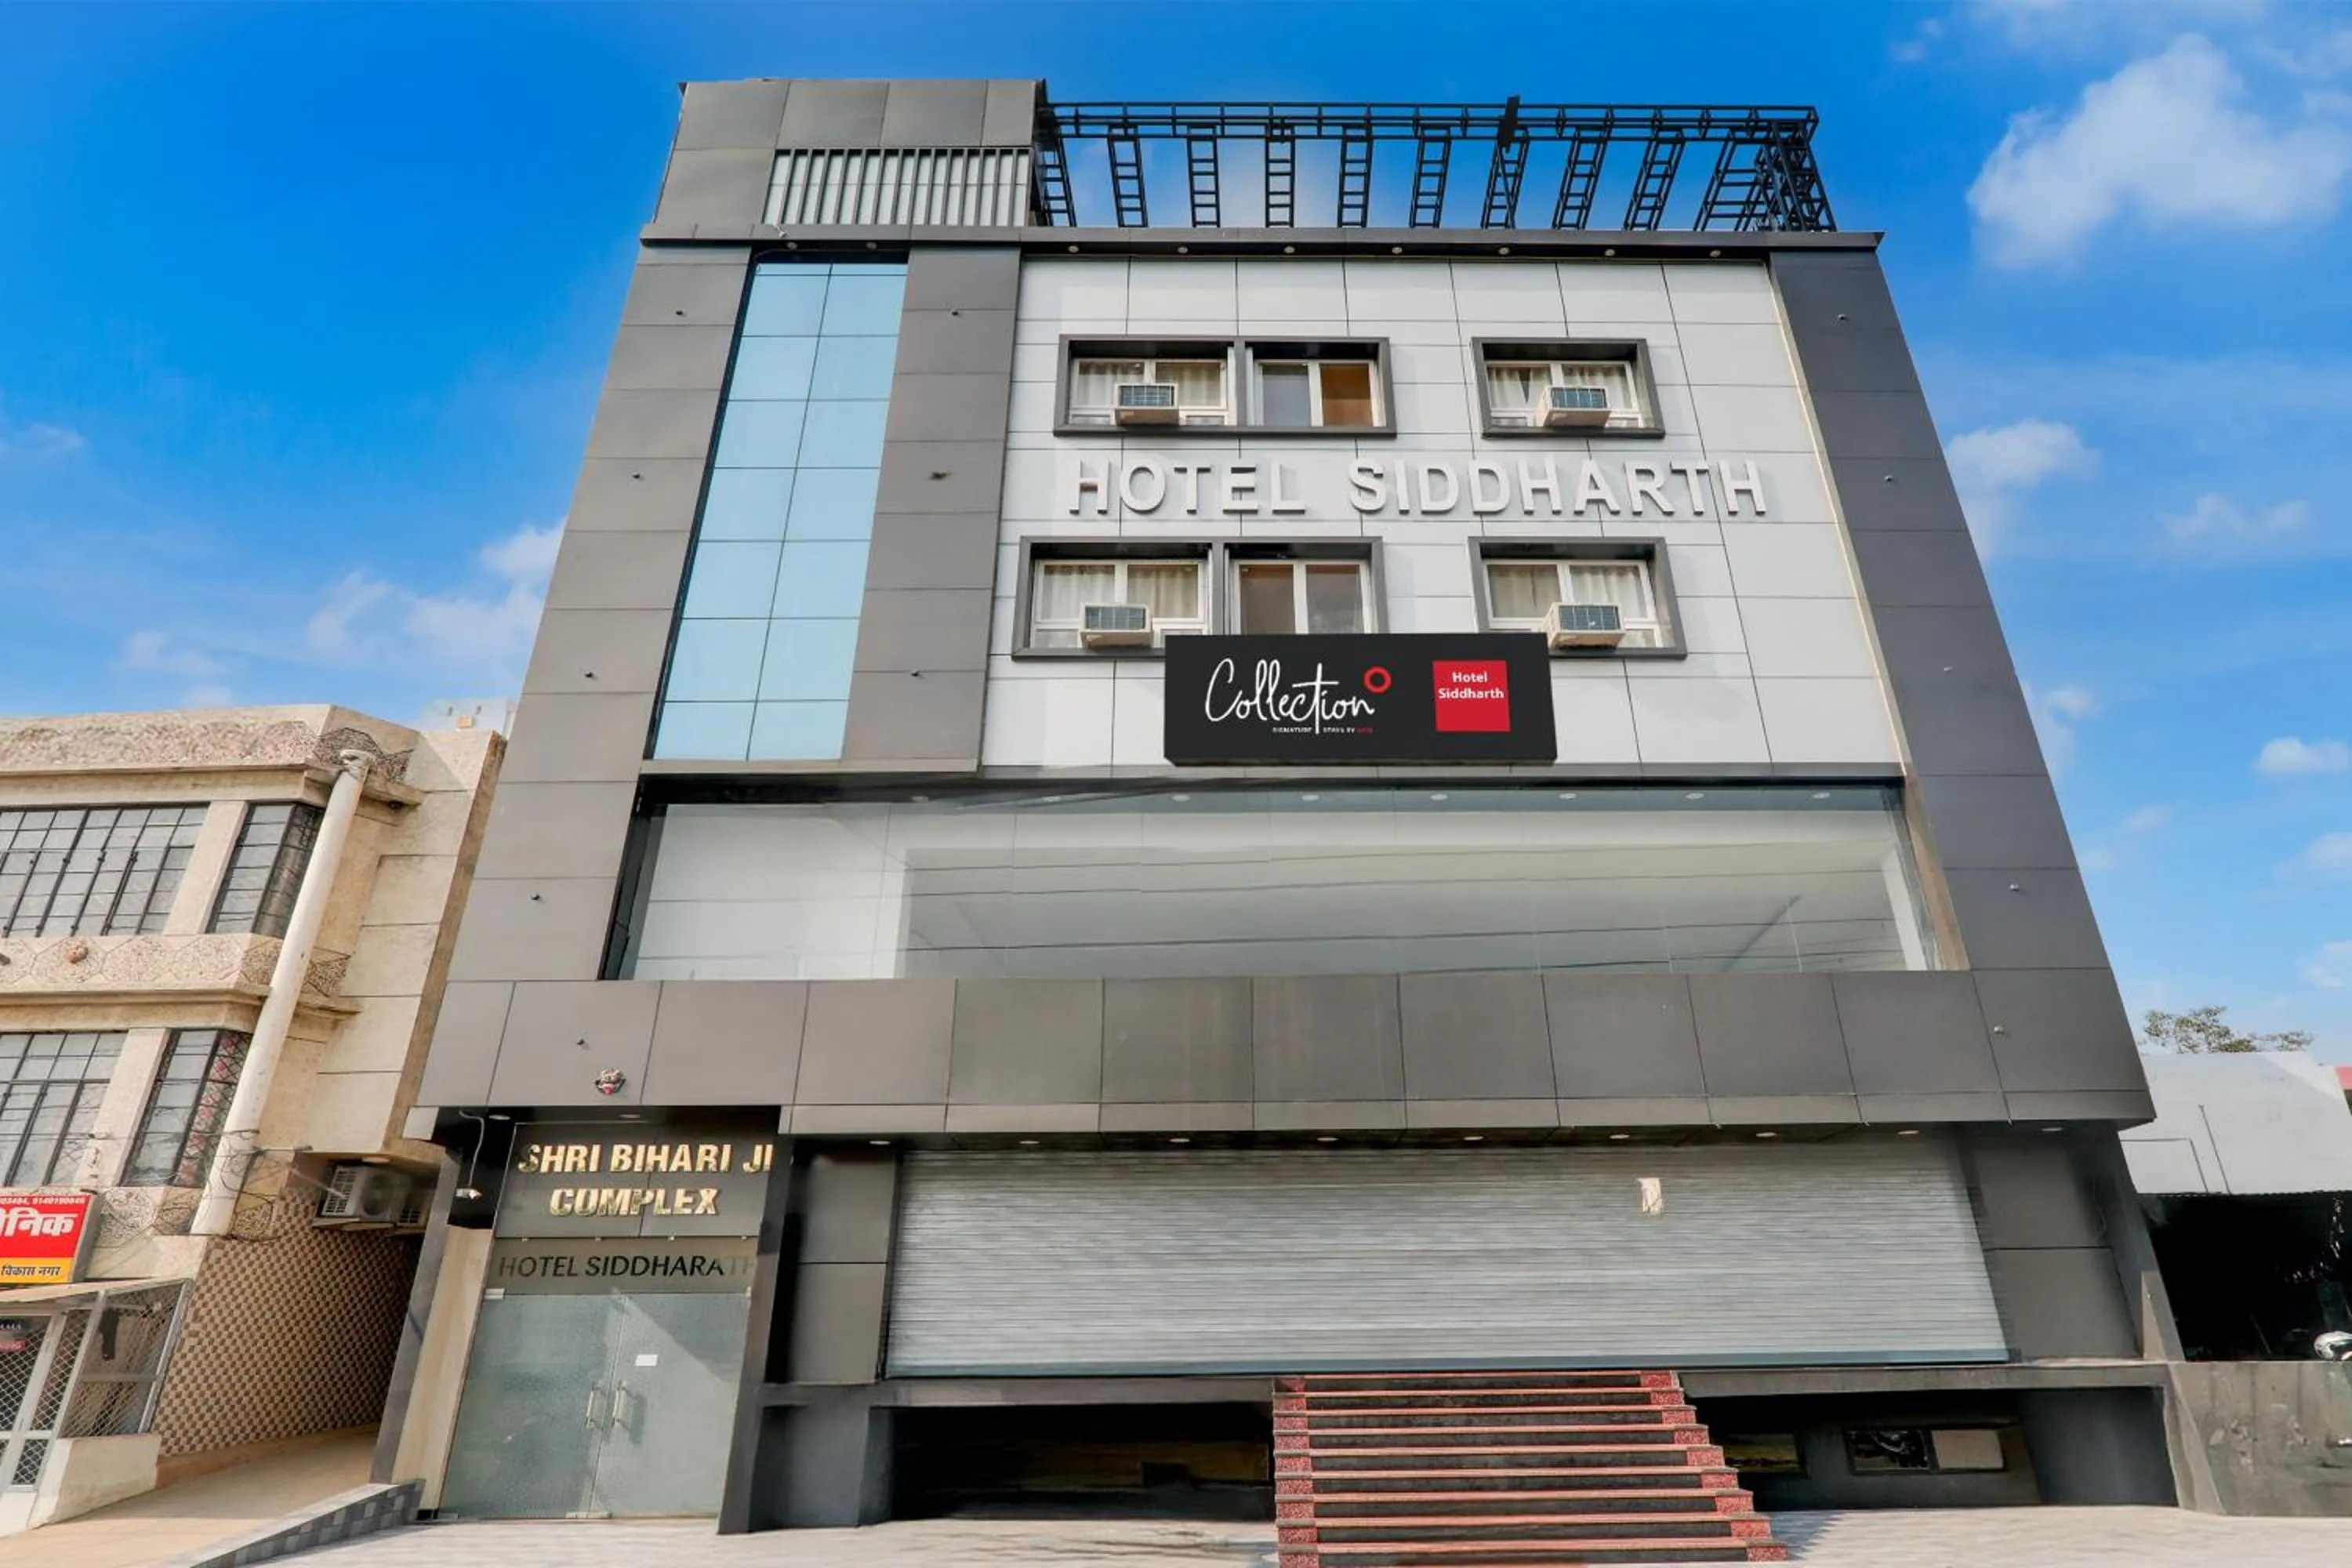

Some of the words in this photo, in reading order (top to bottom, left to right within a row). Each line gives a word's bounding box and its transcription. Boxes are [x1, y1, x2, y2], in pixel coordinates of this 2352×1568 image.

[1068, 457, 1306, 516] HOTEL
[1347, 457, 1769, 517] SIDDHARTH
[1452, 671, 1488, 683] Hotel
[1205, 658, 1375, 735] Collection
[1438, 687, 1504, 699] Siddharth
[517, 1143, 603, 1173] SHRI
[610, 1143, 731, 1174] BIHARI
[742, 1143, 775, 1173] JI
[550, 1187, 720, 1217] COMPLEX
[498, 1256, 579, 1278] HOTEL
